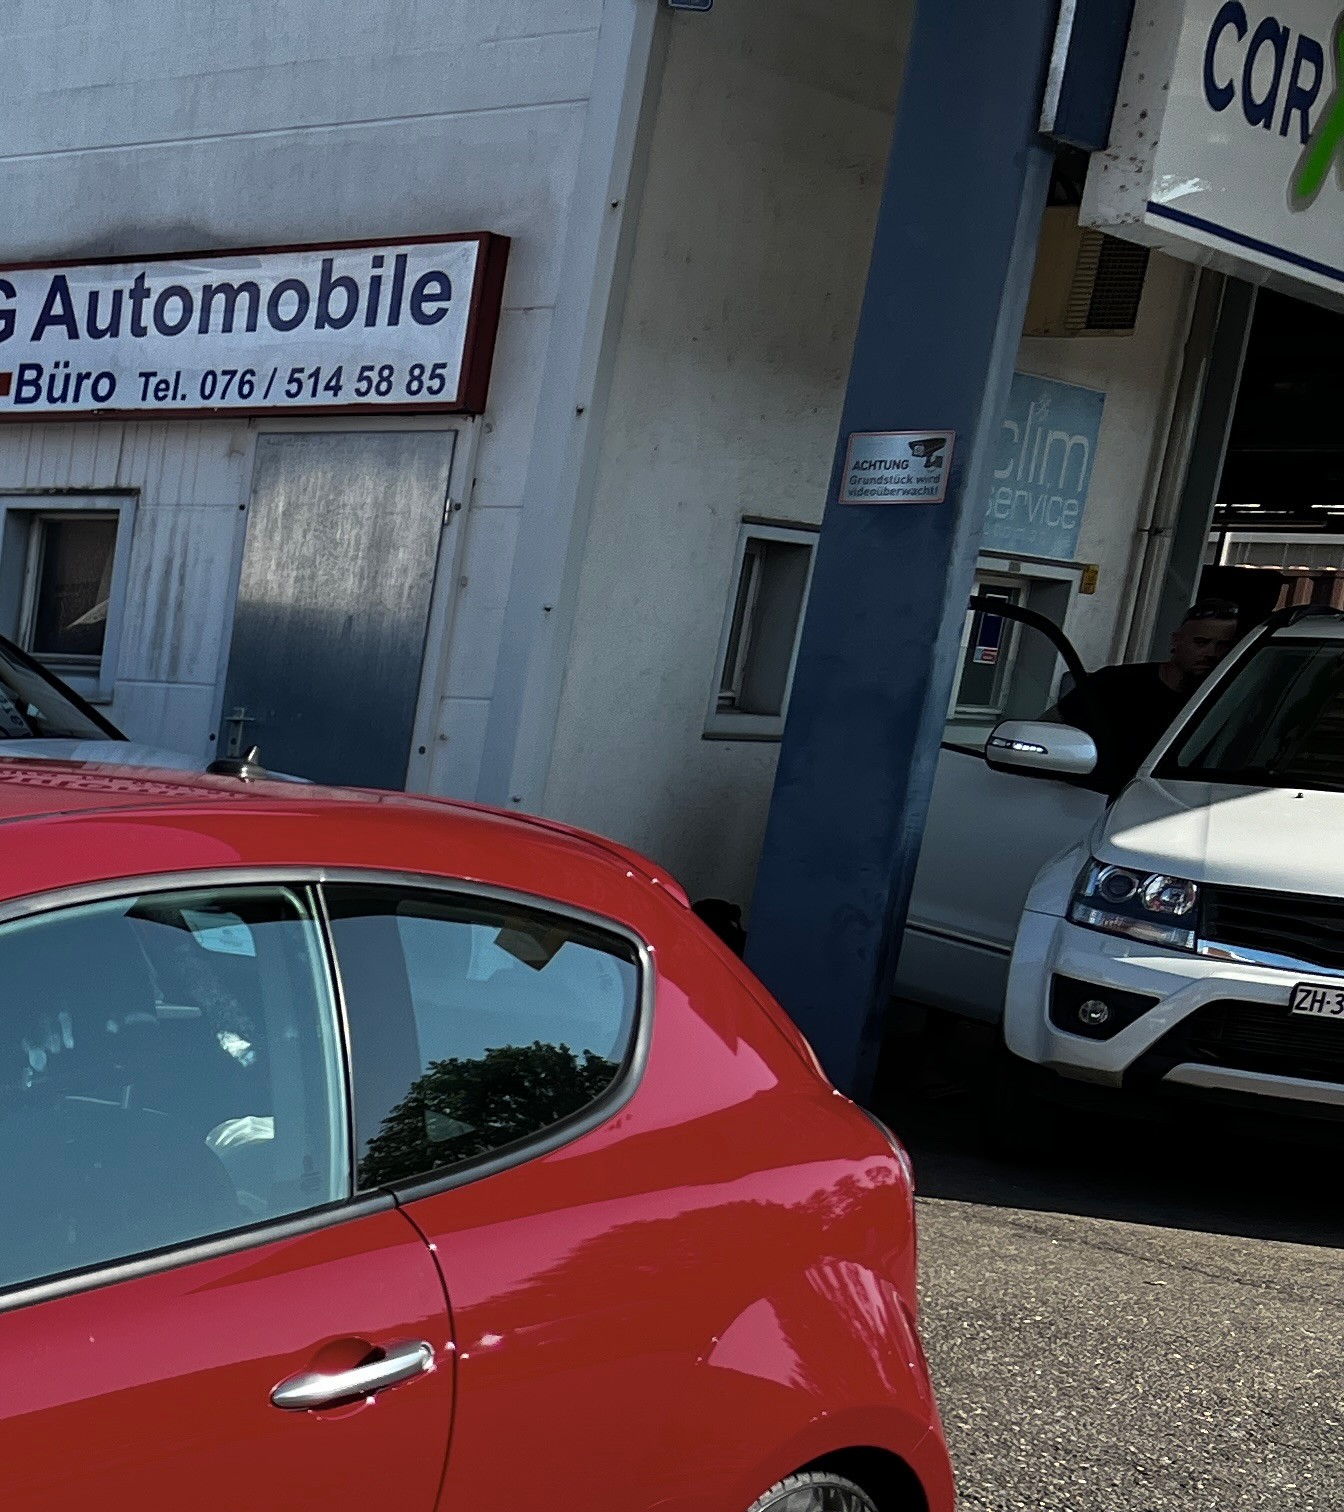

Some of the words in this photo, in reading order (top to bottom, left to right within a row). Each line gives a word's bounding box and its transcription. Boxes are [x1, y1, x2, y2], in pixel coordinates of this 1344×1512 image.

[30, 252, 453, 341] Automobile
[13, 361, 118, 405] Büro
[136, 370, 187, 401] Tel.
[200, 368, 255, 399] 076
[285, 365, 344, 398] 514
[355, 364, 394, 397] 58
[405, 362, 448, 396] 85
[849, 473, 914, 485] Grundstück
[916, 473, 941, 485] wird
[852, 459, 910, 471] ACHTUNG
